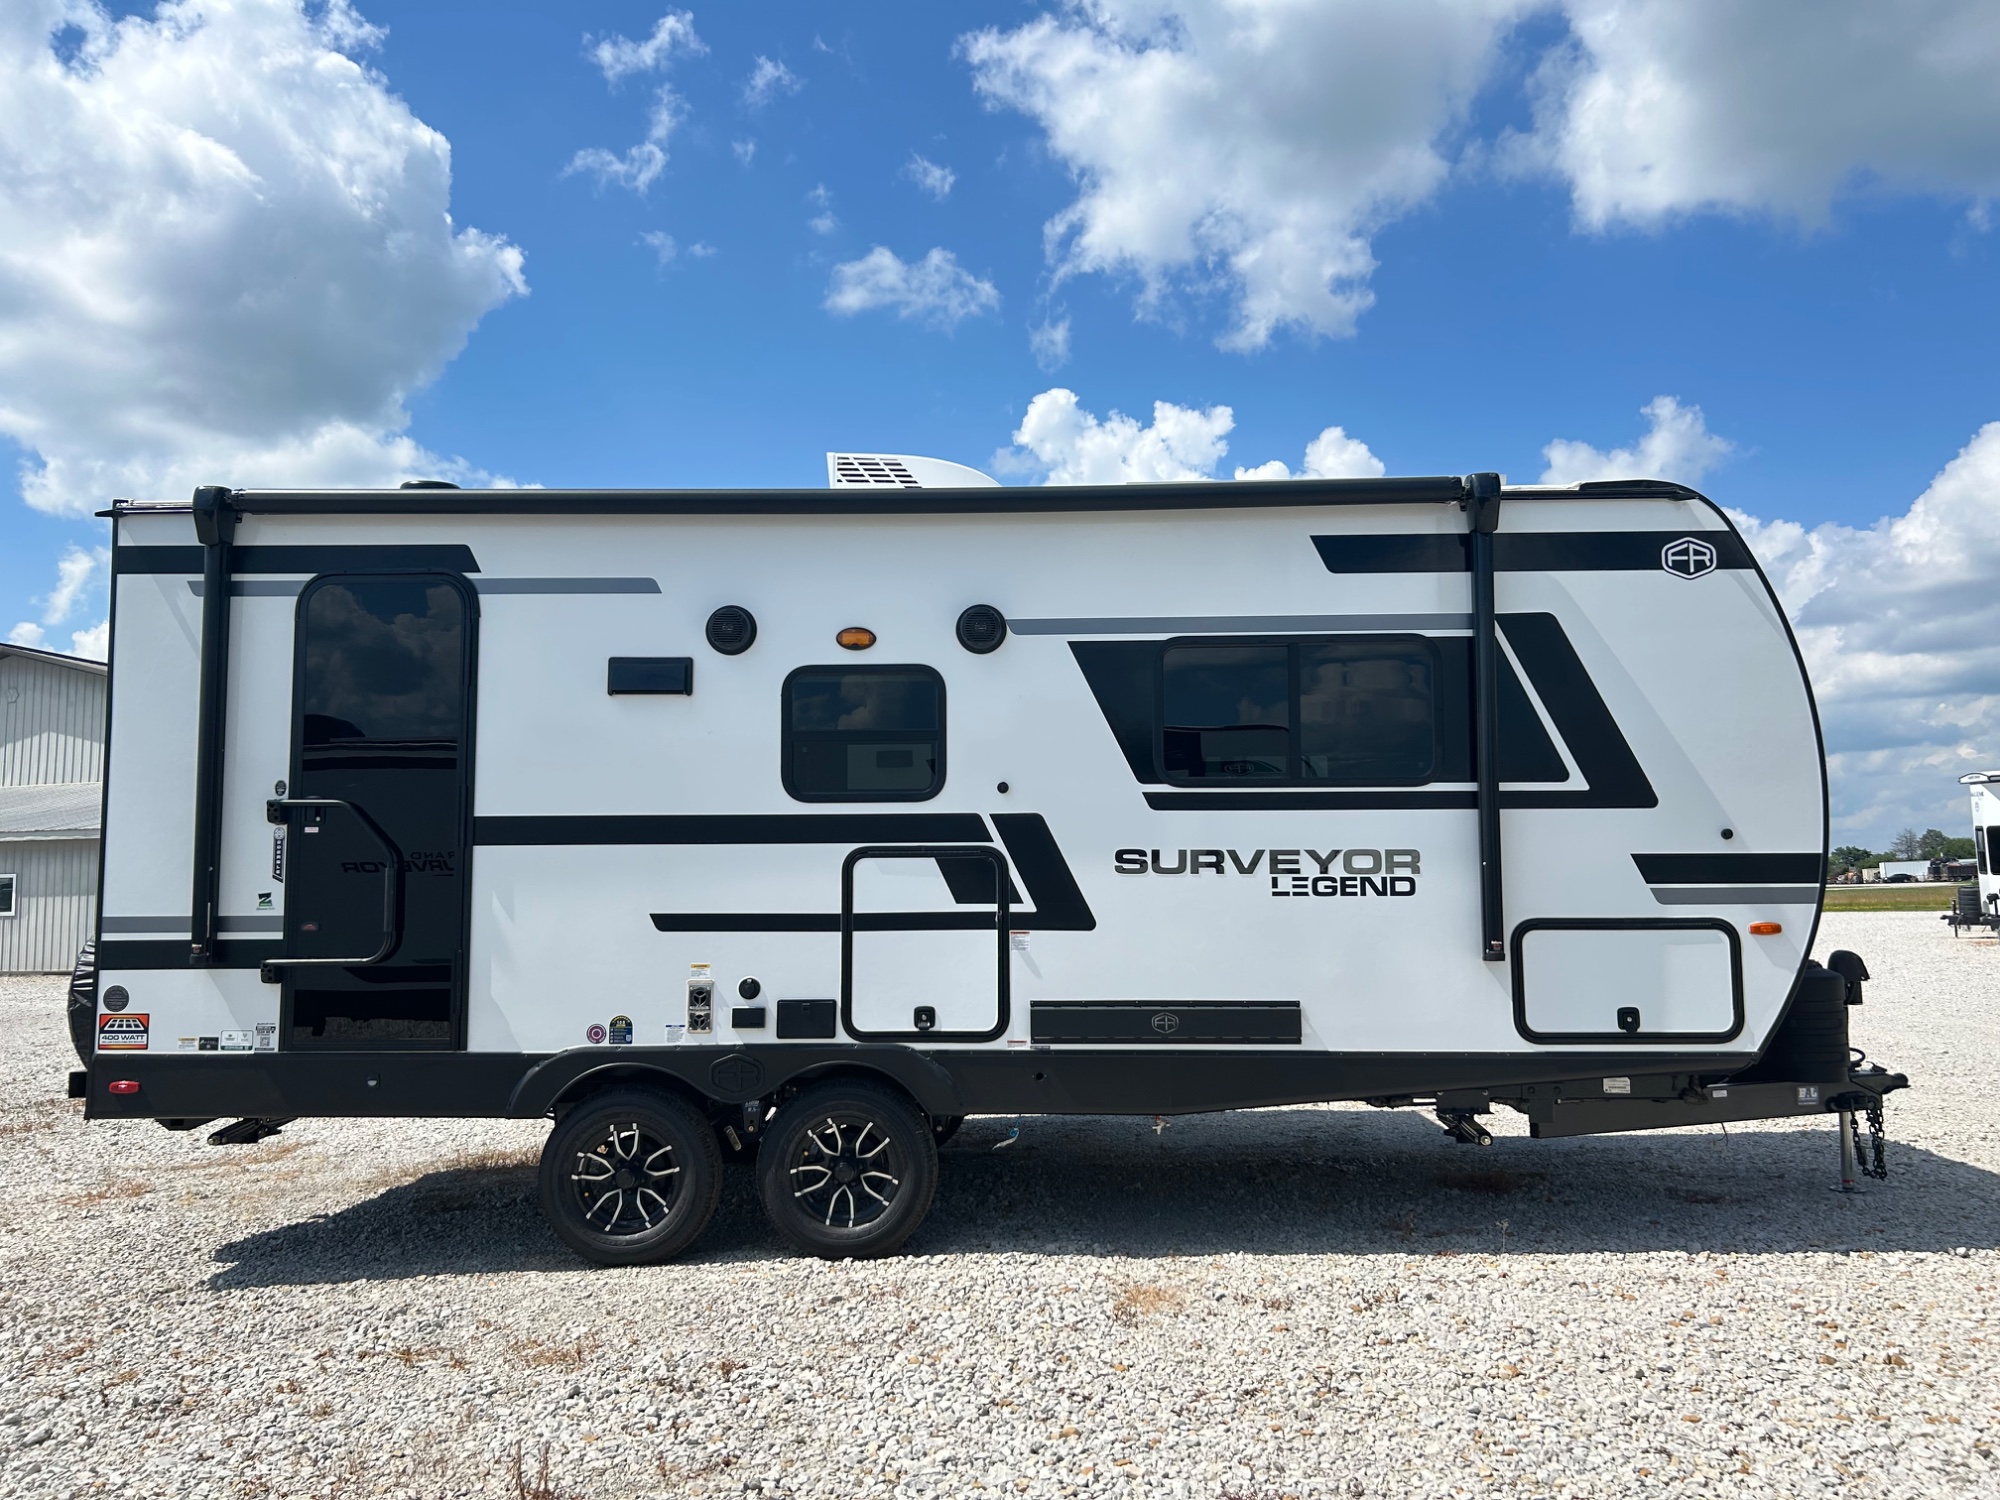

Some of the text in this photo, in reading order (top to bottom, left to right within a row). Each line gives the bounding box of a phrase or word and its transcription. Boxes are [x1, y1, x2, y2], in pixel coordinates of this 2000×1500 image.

[1666, 541, 1712, 574] FR
[1113, 848, 1422, 875] SURVEYOR
[1271, 876, 1417, 897] LEGEND
